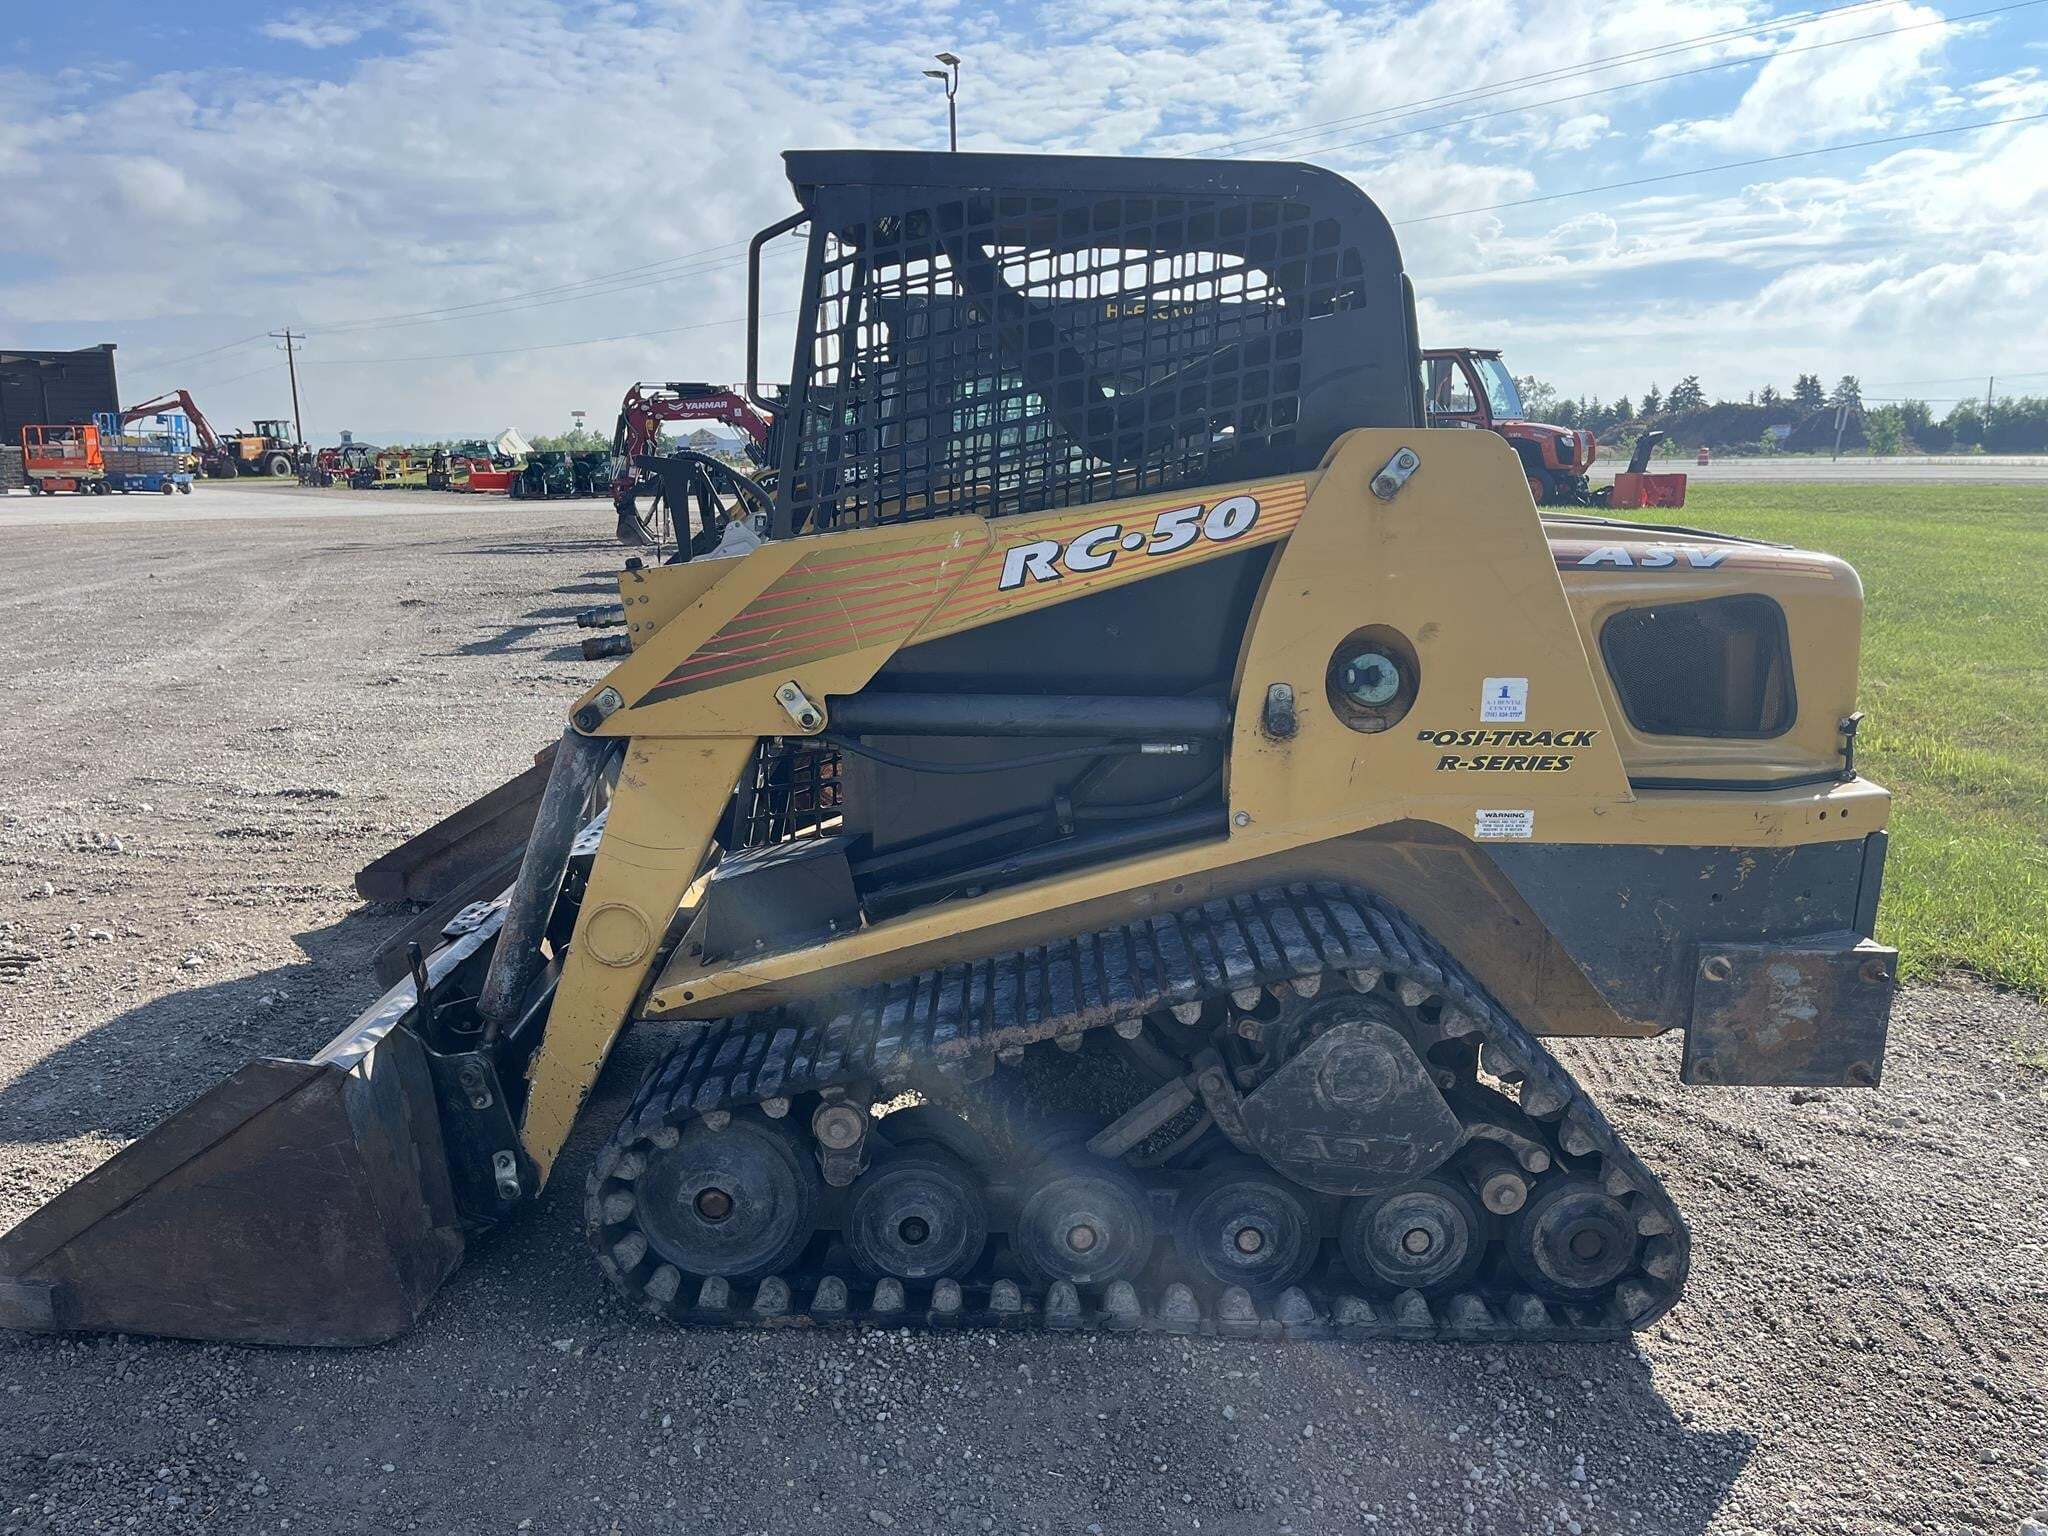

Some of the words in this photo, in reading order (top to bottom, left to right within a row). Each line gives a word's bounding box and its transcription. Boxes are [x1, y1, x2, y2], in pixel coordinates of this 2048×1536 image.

[685, 401, 728, 410] YANMAR
[1577, 546, 1733, 570] ASV
[1498, 686, 1511, 698] 1
[1435, 755, 1576, 773] R-SERIES
